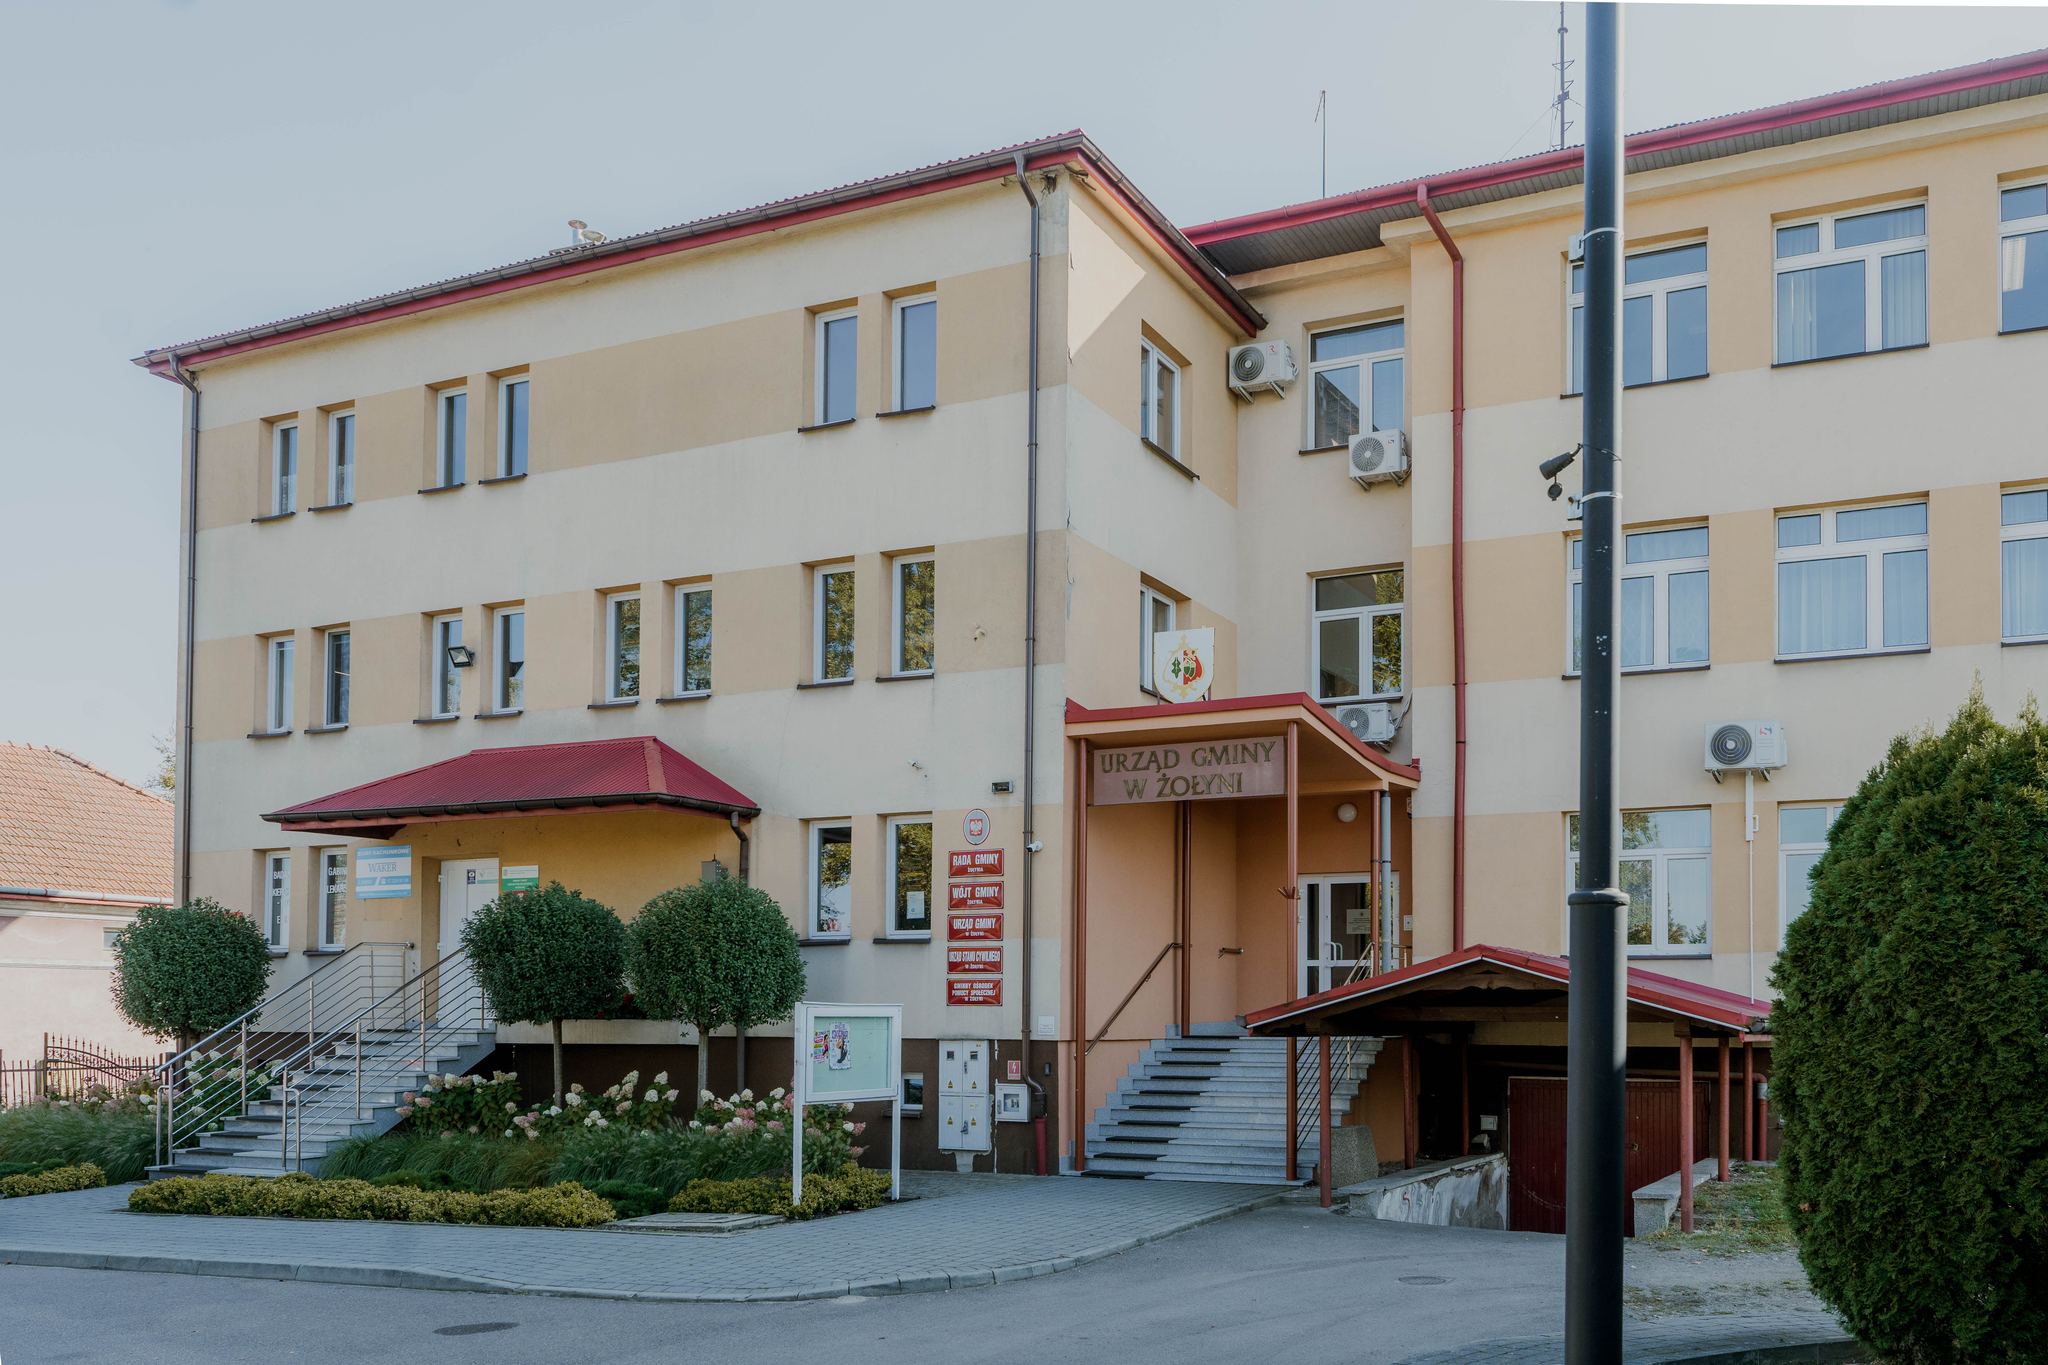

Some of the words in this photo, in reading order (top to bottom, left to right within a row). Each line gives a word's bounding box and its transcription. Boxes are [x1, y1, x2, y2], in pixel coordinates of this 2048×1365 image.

[1100, 749, 1180, 774] URZĄD
[1191, 741, 1277, 767] GMINY
[1122, 778, 1148, 800] W
[1157, 773, 1242, 797] ŻOŁYNI
[952, 854, 972, 866] RADA
[975, 854, 999, 865] GMINY
[952, 885, 972, 899] WÓJT
[975, 886, 1000, 898] GMINY
[953, 918, 973, 931] URZĄD
[975, 917, 997, 929] GMINY
[976, 951, 1001, 962] CYWILNEGO
